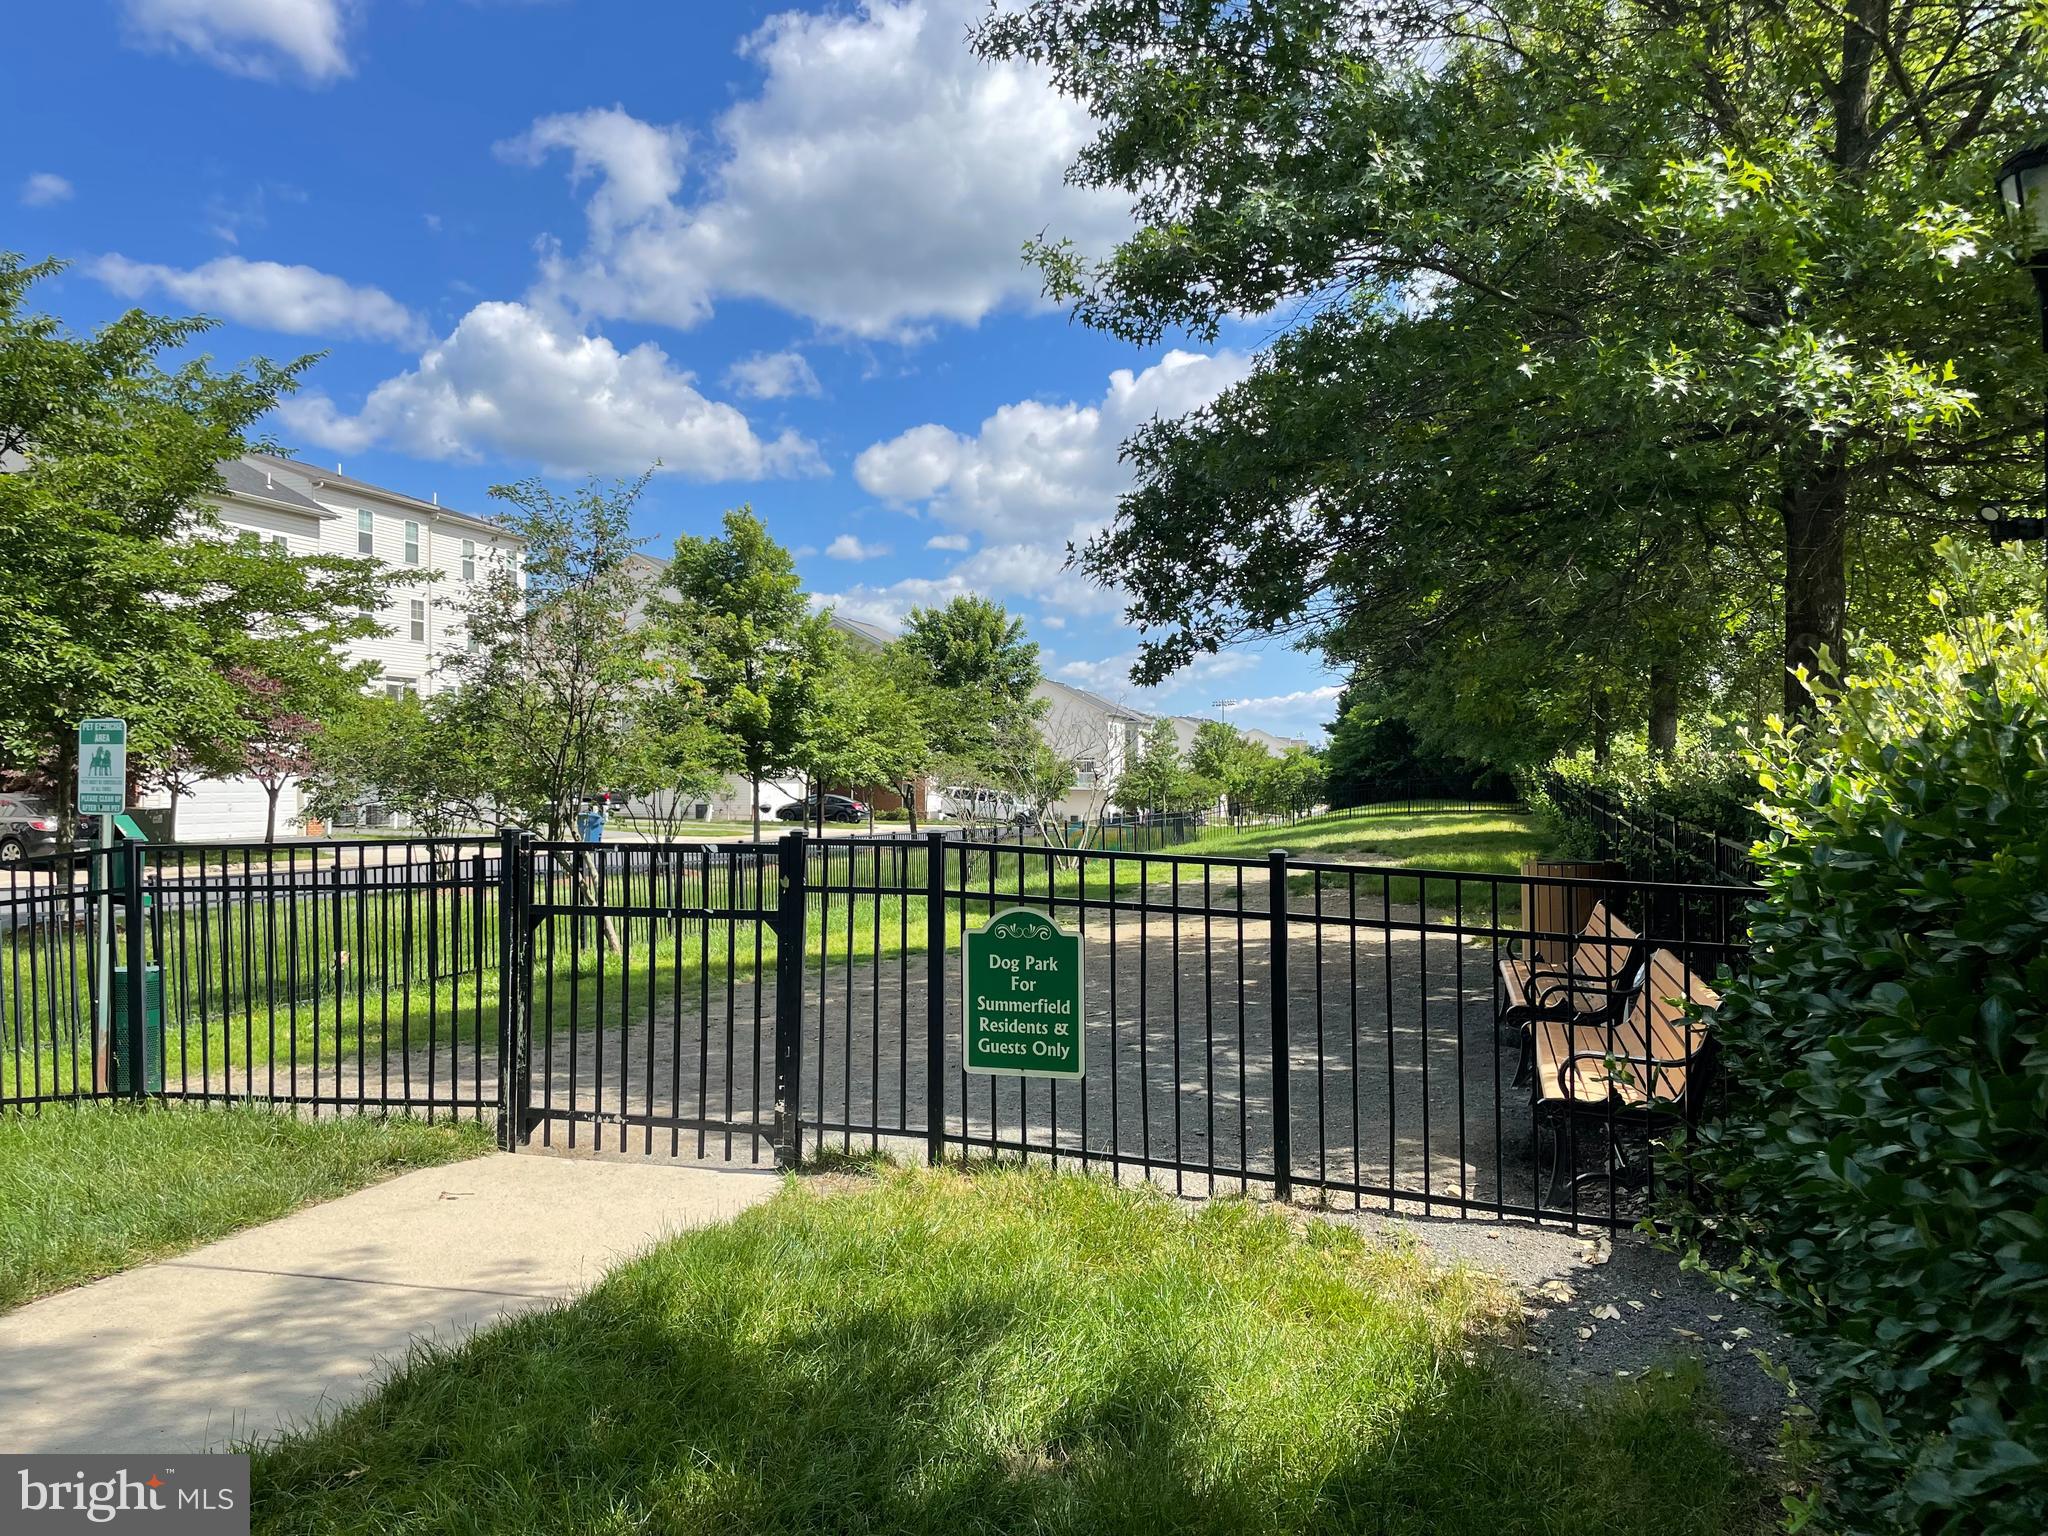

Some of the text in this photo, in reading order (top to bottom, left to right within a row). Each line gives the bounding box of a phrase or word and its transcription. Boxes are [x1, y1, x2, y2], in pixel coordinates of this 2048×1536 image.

[82, 722, 93, 731] PET
[94, 733, 111, 743] AREA
[115, 795, 122, 803] UP
[82, 804, 97, 812] AFTER
[110, 804, 120, 812] PET
[989, 954, 1058, 972] Dog Park
[1011, 976, 1036, 992] For
[977, 995, 1071, 1015] Summerfield
[979, 1016, 1069, 1036] Residents &
[978, 1038, 1070, 1060] Guests Only
